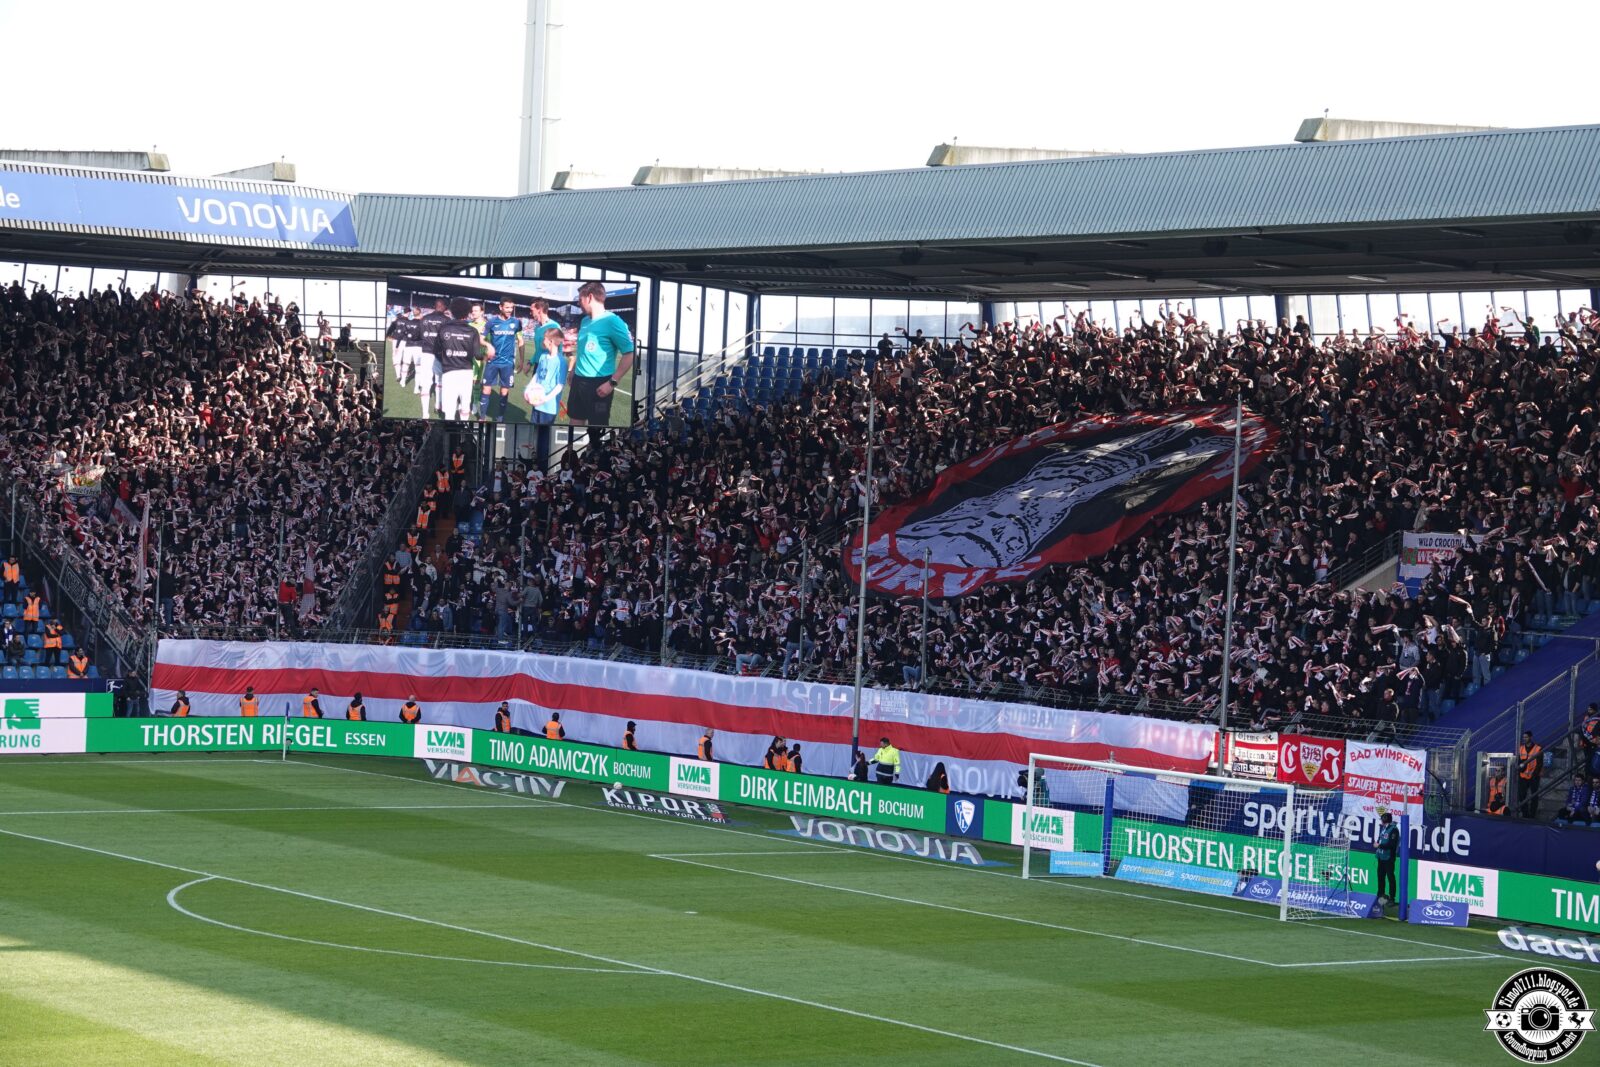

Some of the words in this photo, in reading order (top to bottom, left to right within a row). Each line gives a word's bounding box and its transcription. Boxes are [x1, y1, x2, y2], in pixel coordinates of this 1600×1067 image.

[141, 724, 253, 746] THORSTEN
[262, 723, 337, 747] RIEGEL
[345, 732, 386, 746] ESSEN
[427, 731, 456, 748] LVM
[489, 739, 523, 764] TIMO
[529, 744, 608, 777] ADAMCZYK
[613, 762, 651, 779] BOCHUM
[1350, 749, 1371, 762] BAD
[1375, 748, 1422, 772] WIMPFEN
[424, 759, 566, 798] VIACTIV
[1348, 777, 1378, 792] STAUFER
[602, 787, 704, 816] KIPOR
[740, 774, 778, 802] DIRK
[784, 780, 872, 816] LEIMBACH
[878, 799, 924, 819] BOCHUM
[1124, 828, 1234, 870] THORSTEN
[1327, 863, 1369, 885] ESSEN
[1121, 863, 1175, 878] sportwetten.de
[1180, 872, 1233, 888] sportwetten.de
[1431, 870, 1466, 895] LVM
[1251, 884, 1271, 897] Seco
[1350, 900, 1367, 911] Tor
[1425, 906, 1453, 917] Seco
